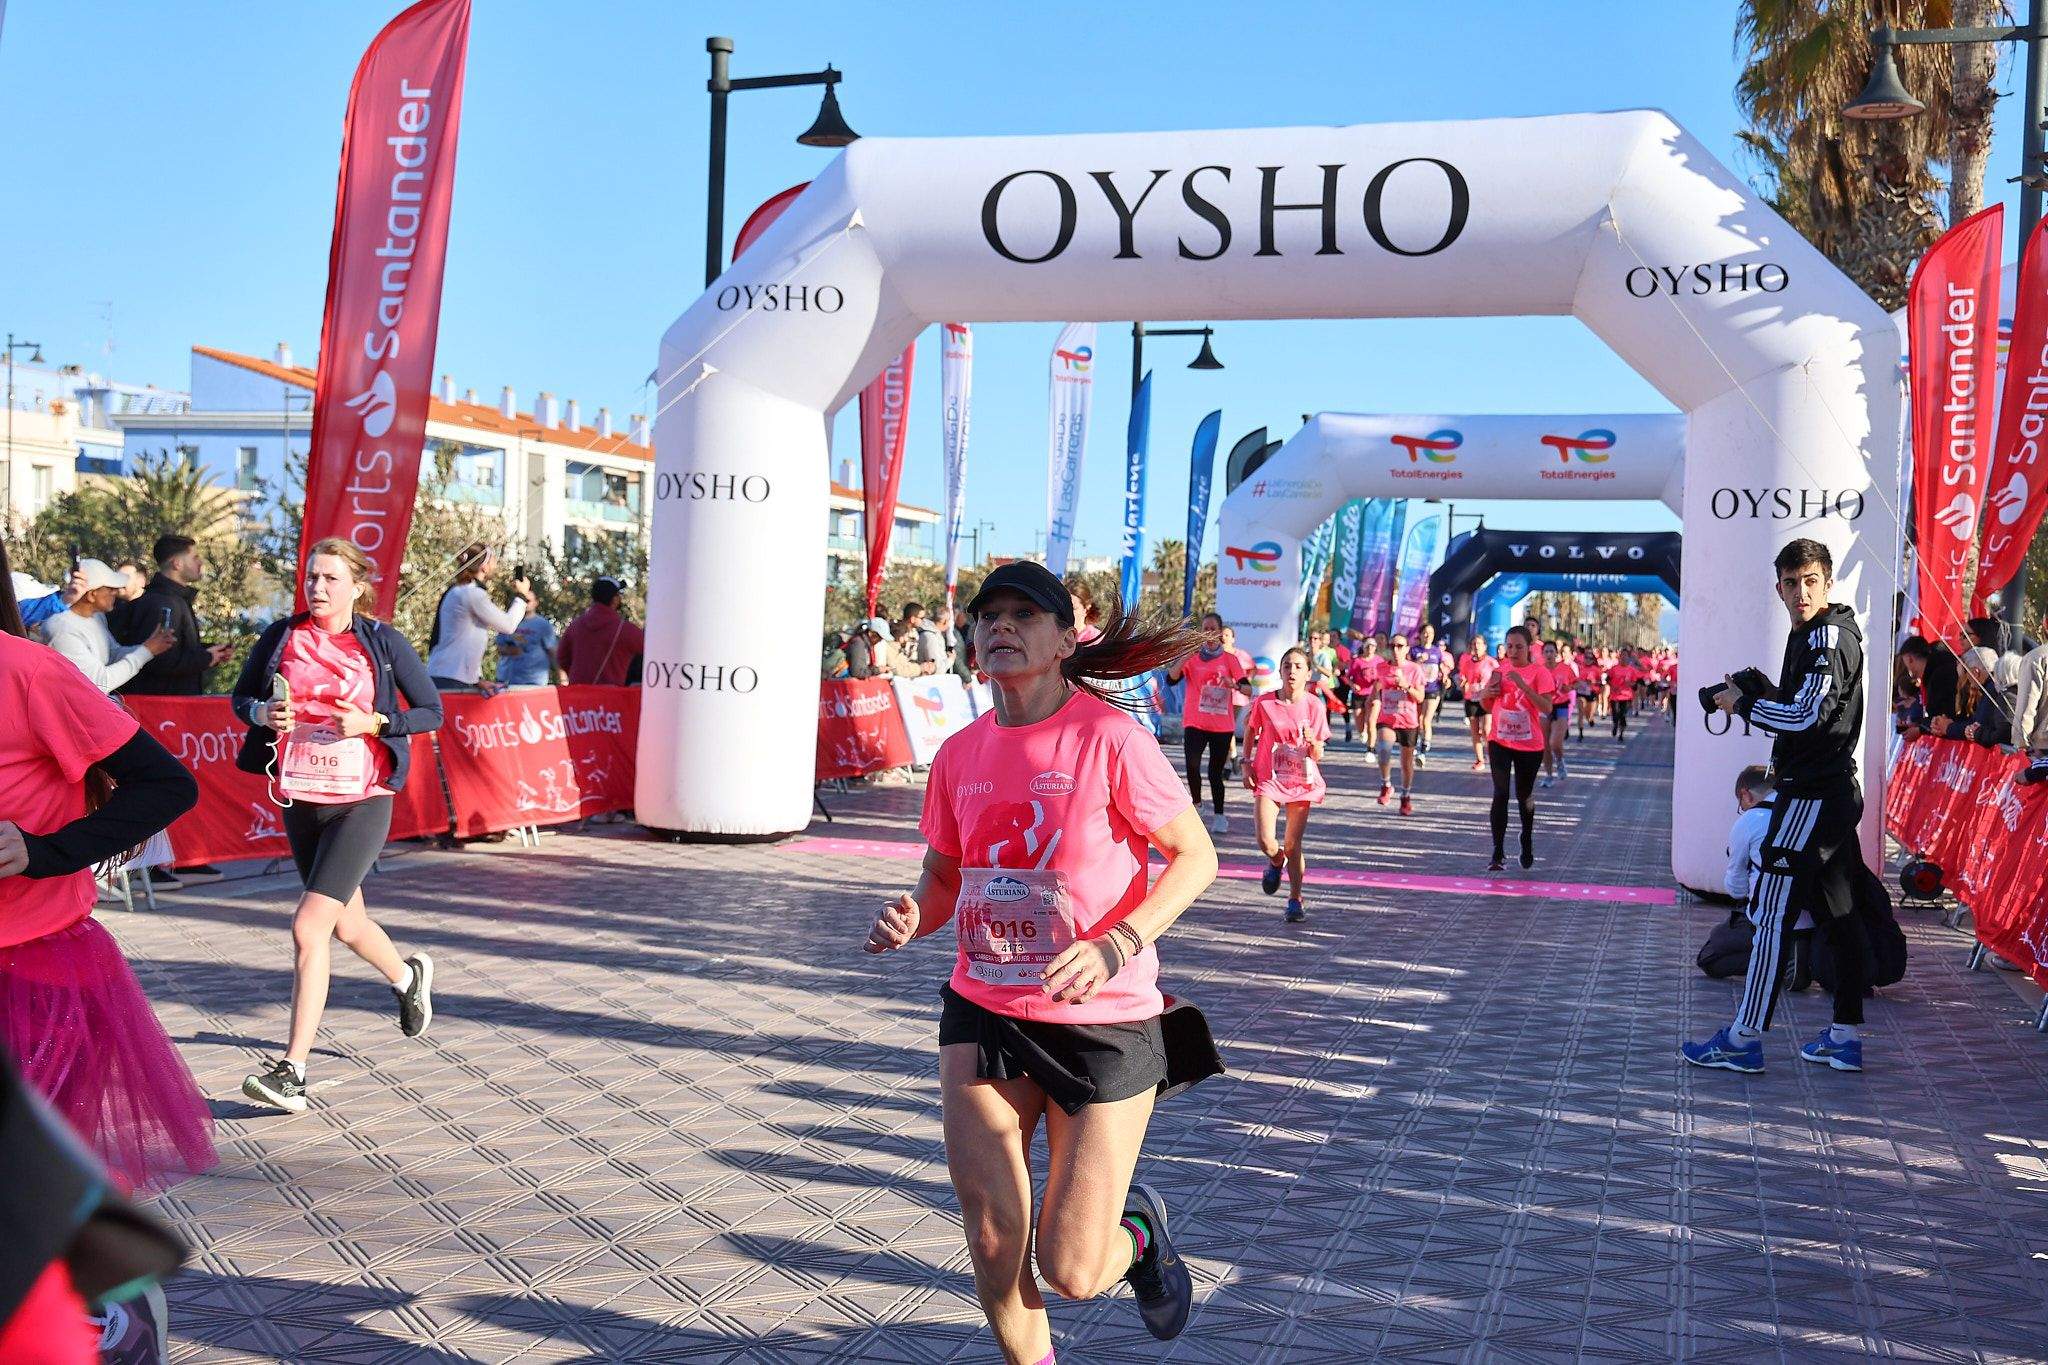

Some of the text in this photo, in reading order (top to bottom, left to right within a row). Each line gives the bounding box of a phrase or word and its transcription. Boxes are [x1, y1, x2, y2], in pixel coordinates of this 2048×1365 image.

[364, 79, 432, 360] Santander
[981, 158, 1470, 264] OYSHO
[1625, 263, 1789, 298] OYSHO
[717, 285, 844, 314] OYSHO
[1941, 282, 1976, 486] Santander
[1390, 469, 1463, 480] TotalEnergies
[1540, 469, 1616, 480] TotalEnergies
[656, 472, 770, 502] OYSHO
[1711, 487, 1864, 520] OYSHO
[1508, 544, 1645, 560] VOLVO
[646, 661, 758, 694] OYSHO
[455, 704, 622, 757] Sports Santander
[310, 754, 338, 767] 016
[957, 781, 993, 798] OYSHO
[1033, 780, 1074, 790] ASTURIANA
[986, 884, 1027, 896] ASTURIANA
[991, 920, 1037, 938] 016
[1001, 944, 1024, 953] 4173
